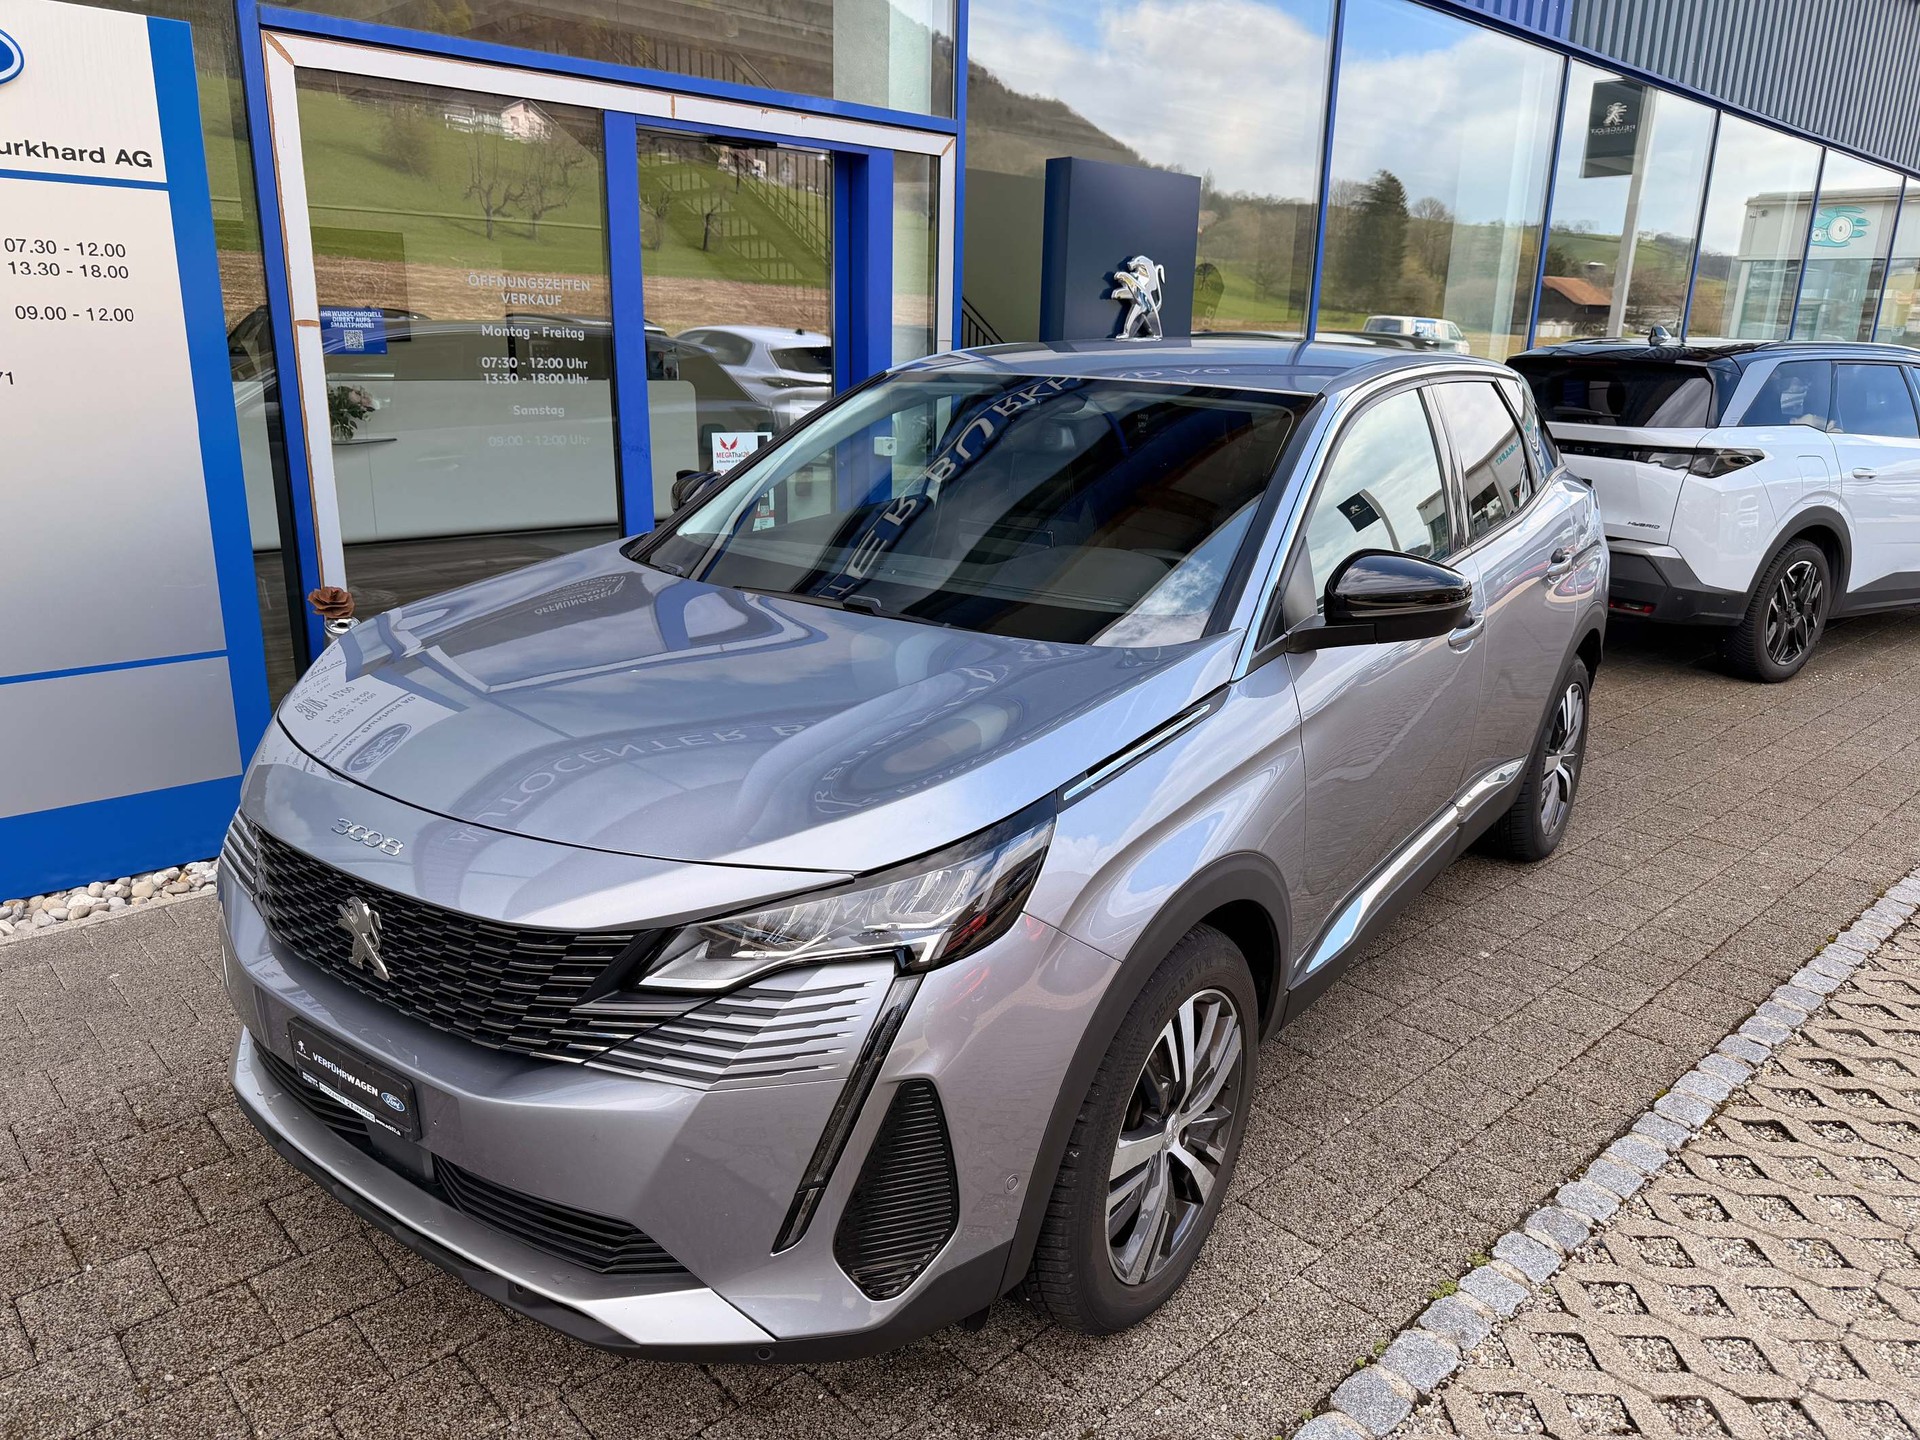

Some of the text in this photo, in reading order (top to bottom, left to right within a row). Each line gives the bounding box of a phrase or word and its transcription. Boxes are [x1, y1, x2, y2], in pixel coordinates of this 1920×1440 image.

[115, 149, 153, 168] AG
[4, 238, 57, 255] 07.30
[76, 242, 126, 258] 12.00
[8, 261, 60, 276] 13.30
[79, 264, 129, 279] 18.00
[468, 272, 591, 292] ÖFFNUNGSZEITEN
[501, 292, 562, 306] VERKAUF
[15, 305, 67, 321] 09.00
[86, 307, 134, 322] 12.00
[332, 310, 382, 318] WUNSCHMODELL
[481, 325, 530, 339] Montag
[542, 327, 585, 341] Freitag
[481, 357, 518, 369] 07:30
[530, 357, 564, 369] 12:00
[567, 358, 588, 369] Uhr
[484, 373, 519, 385] 13:30
[531, 373, 565, 385] 18:00
[567, 373, 589, 385] Uhr
[513, 405, 565, 417] Samstag
[488, 435, 523, 448] 09:00
[536, 435, 567, 446] 12:00
[331, 818, 405, 856] 3008
[312, 1051, 378, 1097] VERFÜHRWAGEN
